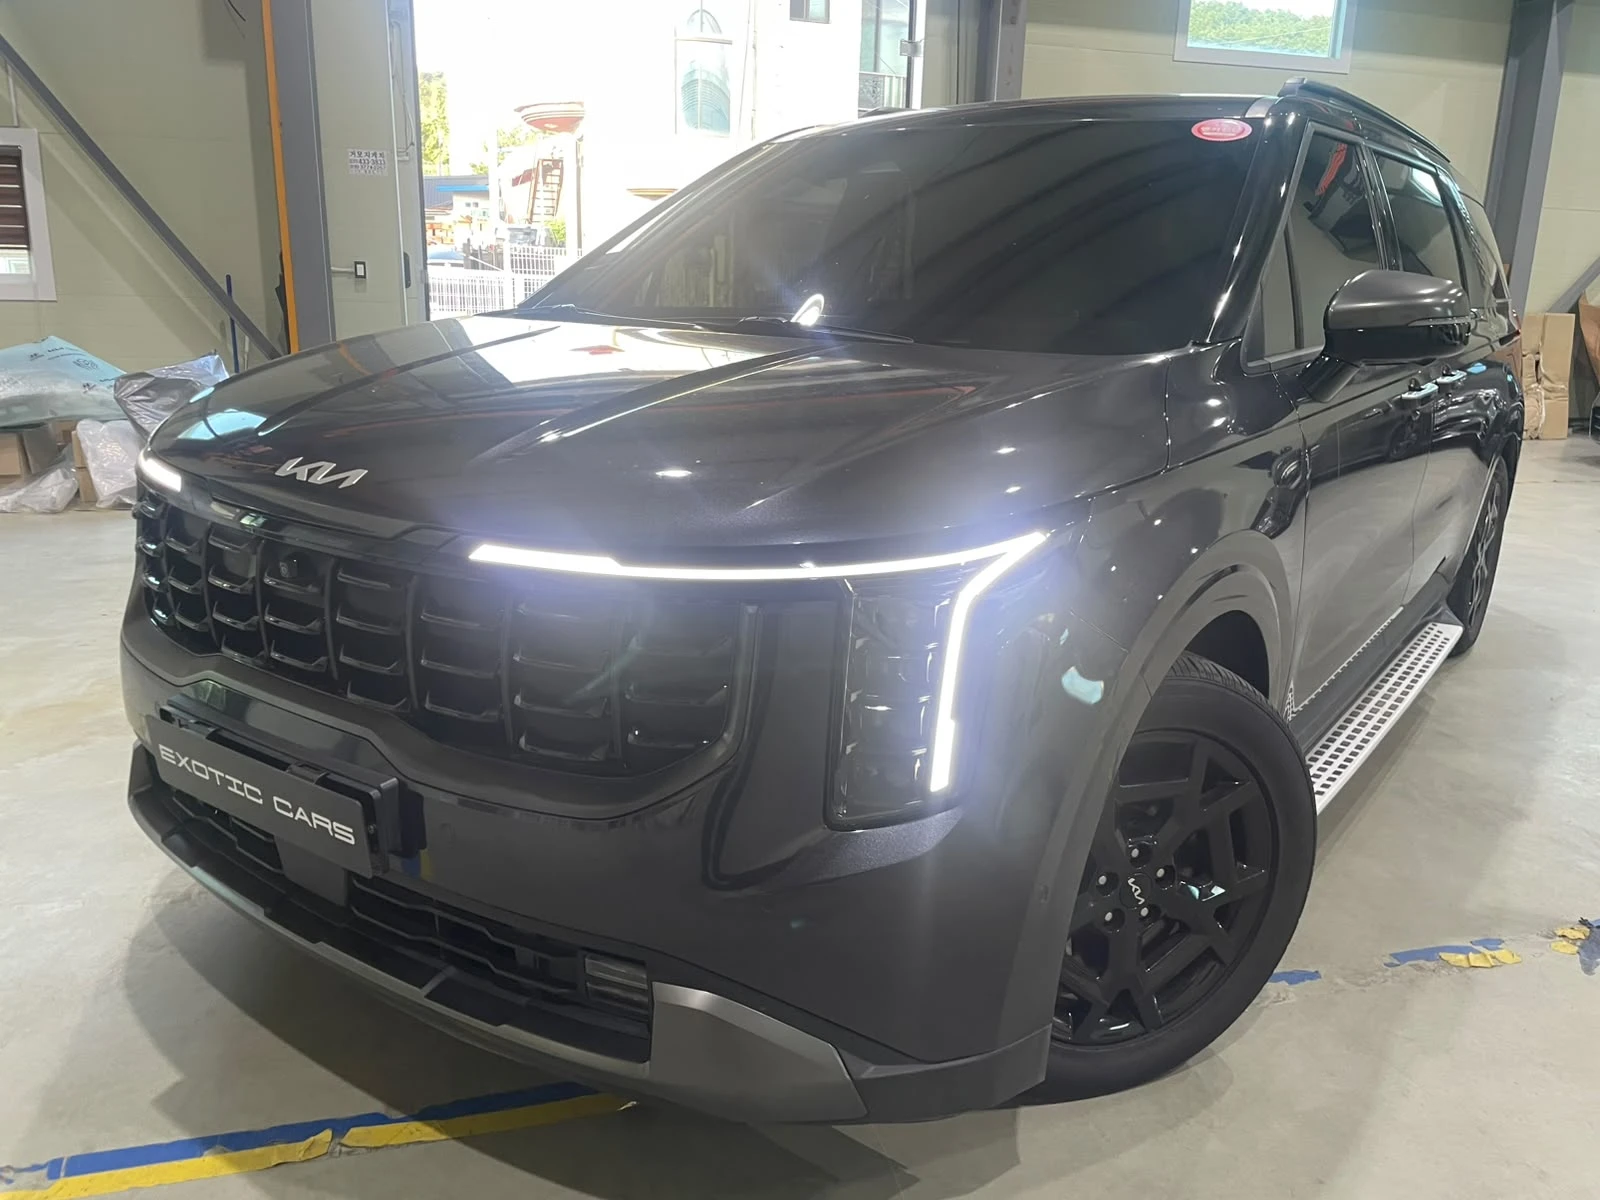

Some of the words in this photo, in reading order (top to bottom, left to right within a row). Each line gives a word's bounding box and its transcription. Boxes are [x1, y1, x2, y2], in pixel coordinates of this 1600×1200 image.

[275, 456, 368, 489] KIA
[159, 744, 263, 804] EXOTIC
[273, 796, 355, 845] CARS
